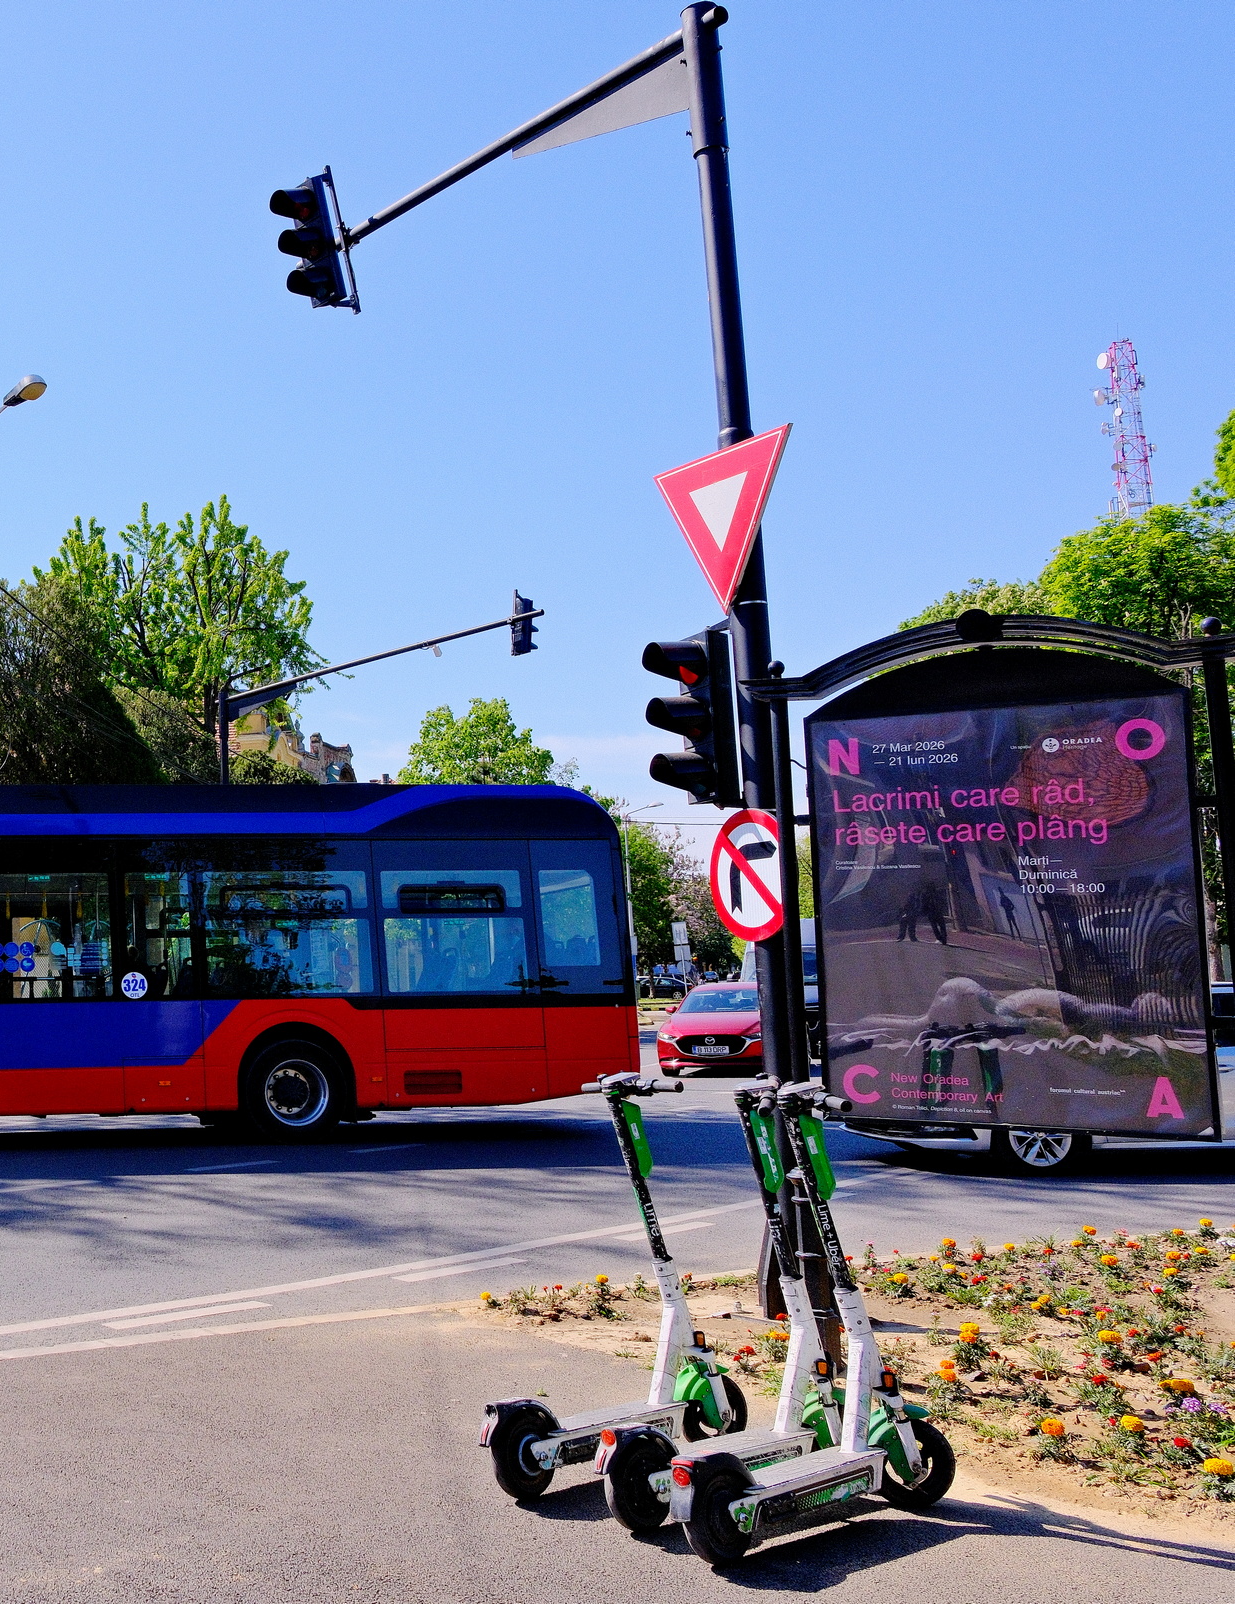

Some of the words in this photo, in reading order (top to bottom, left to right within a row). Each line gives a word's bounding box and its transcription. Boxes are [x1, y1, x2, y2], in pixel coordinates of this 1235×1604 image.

[872, 744, 886, 754] 27
[890, 743, 912, 753] Mar
[916, 740, 945, 751] 2026
[1062, 737, 1102, 745] ORADEA
[1115, 718, 1165, 760] O
[828, 738, 861, 776] N
[889, 756, 902, 766] 21
[907, 755, 925, 765] Iun
[929, 753, 958, 764] 2026
[833, 785, 941, 813] Lacrimi
[950, 786, 1020, 808] care
[1032, 778, 1094, 806] râd,
[835, 822, 926, 846] râsete
[937, 822, 1006, 843] care
[1017, 814, 1108, 847] plâng
[1019, 868, 1078, 880] Duminică
[123, 978, 146, 992] 324
[843, 1064, 881, 1104] C
[890, 1072, 917, 1083] New
[923, 1073, 969, 1086] Oradea
[891, 1087, 978, 1104] Contemporary
[985, 1091, 1003, 1103] Art
[1146, 1076, 1185, 1119] A
[644, 1203, 660, 1236] Lime
[817, 1204, 831, 1231] Lime
[827, 1240, 842, 1271] Uber
